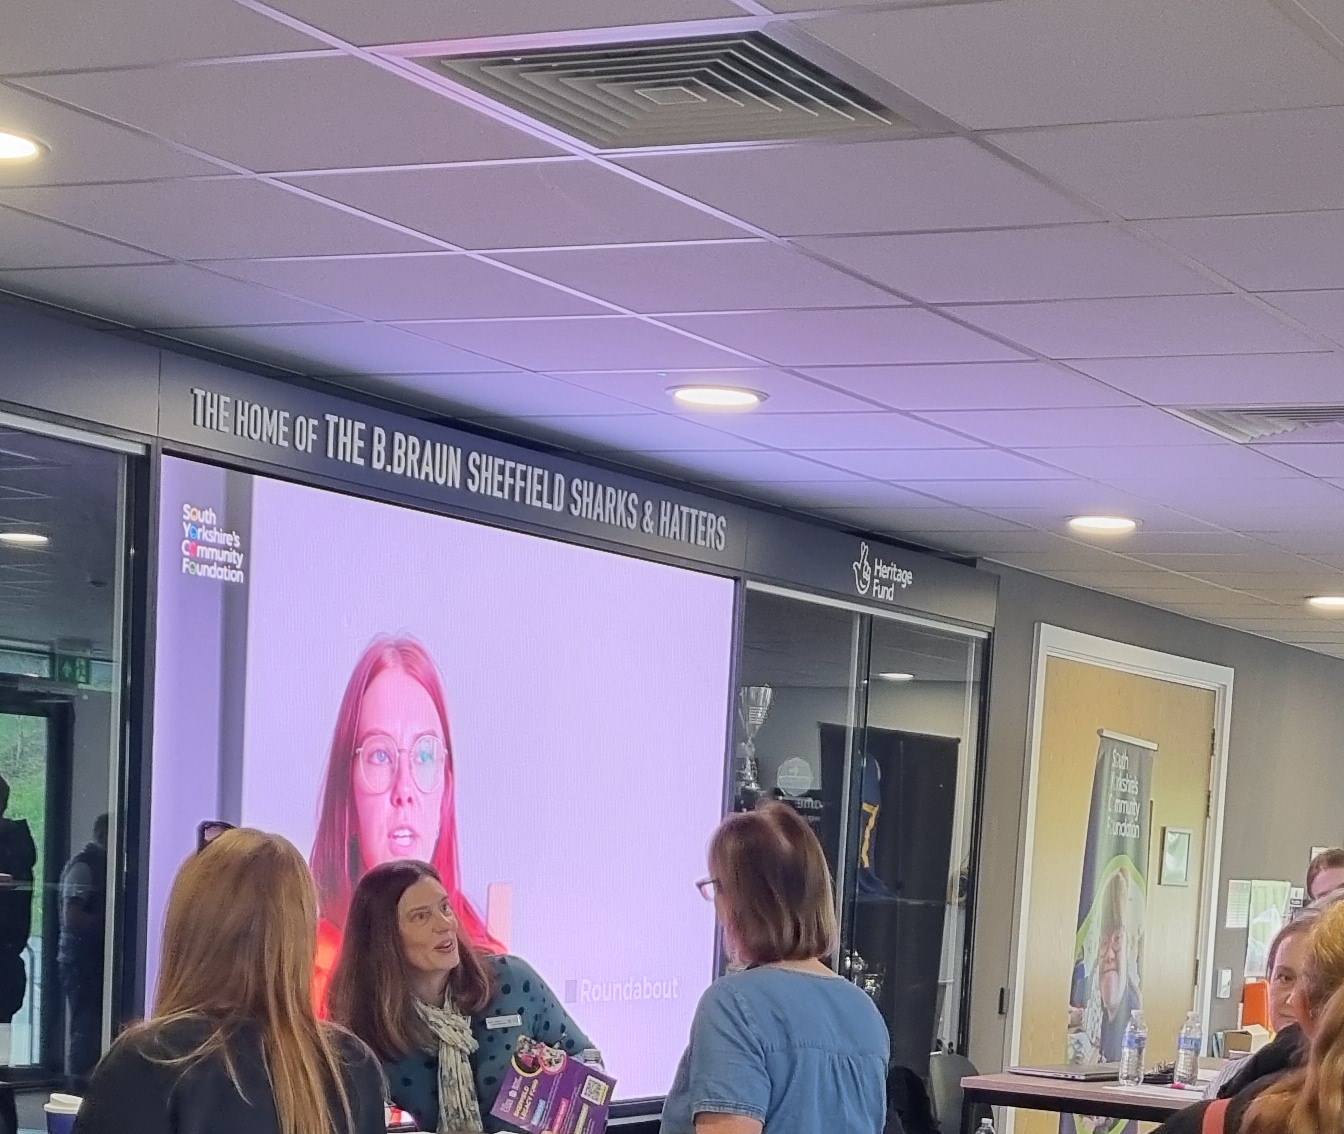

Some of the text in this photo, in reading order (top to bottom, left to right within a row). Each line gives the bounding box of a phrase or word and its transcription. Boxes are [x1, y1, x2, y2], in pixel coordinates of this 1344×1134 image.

[192, 388, 727, 552] THE HOME OF THE B.BRAUN SHEFFIELD SHARKS & HATTERS
[182, 503, 216, 525] South
[182, 521, 241, 548] Yorkshire's
[181, 539, 244, 569] Community
[182, 557, 244, 584] Foundation
[874, 558, 913, 588] Heritage
[872, 582, 895, 601] Fund
[580, 976, 678, 1002] Roundabout
